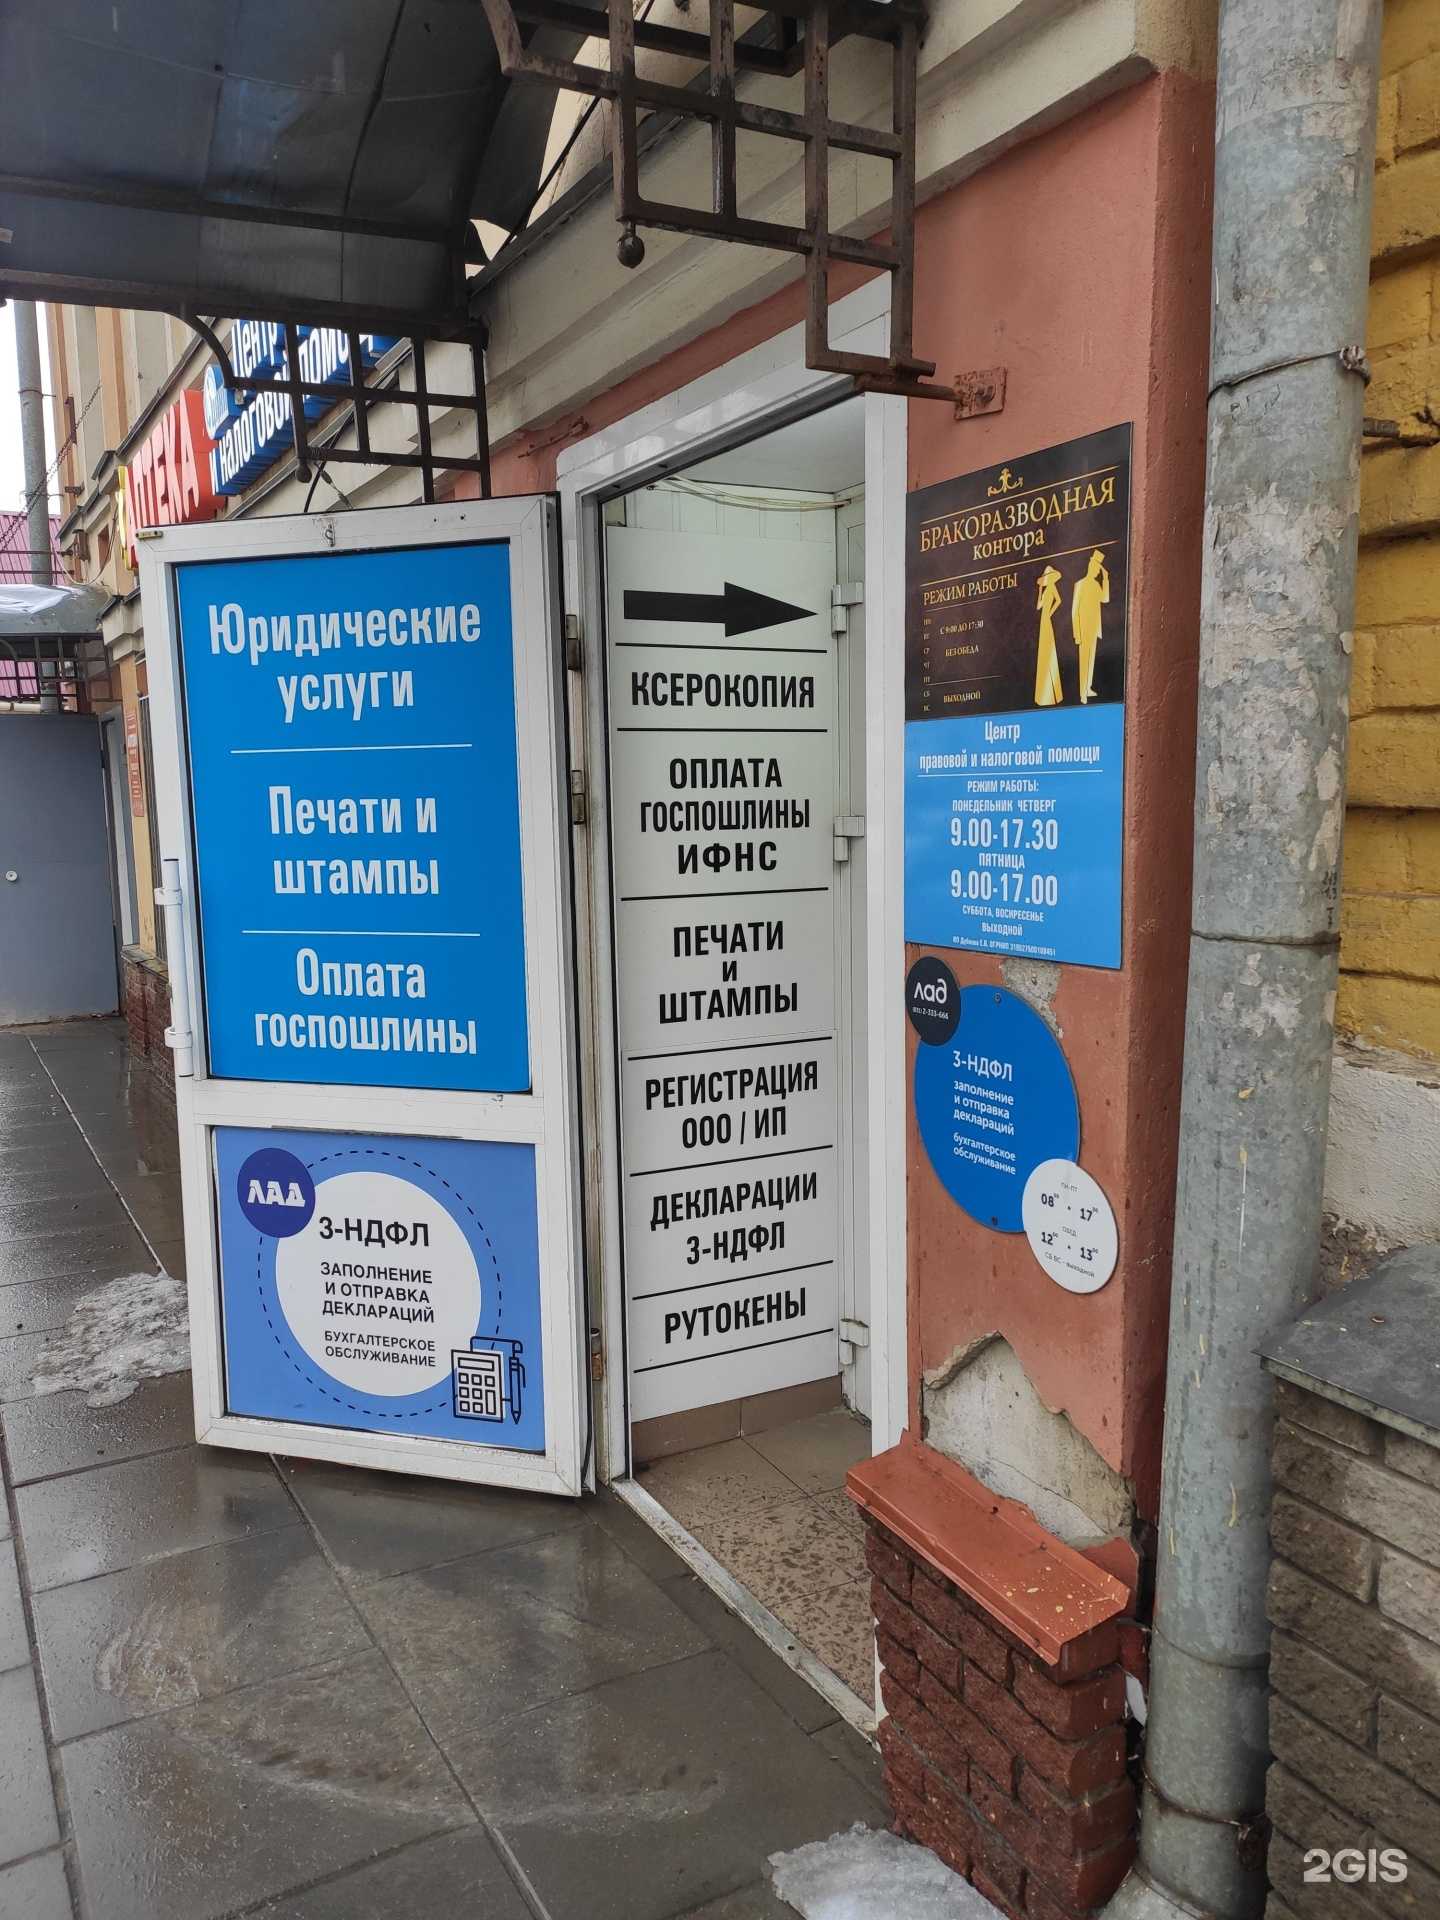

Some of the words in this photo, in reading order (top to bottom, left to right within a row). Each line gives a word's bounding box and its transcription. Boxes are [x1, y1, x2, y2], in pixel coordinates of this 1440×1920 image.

[125, 389, 200, 570] АПТЕКА
[920, 476, 1116, 553] БРАКОРАЗВОДНАЯ
[972, 528, 1046, 561] контора
[923, 583, 966, 606] РЕЖИМ
[968, 572, 1019, 597] РАБОТЫ
[208, 603, 482, 666] Юридические
[277, 670, 415, 724] услуги
[631, 671, 815, 708] КСЕРОКОПИЯ
[984, 720, 1021, 744] Центр
[669, 758, 783, 789] ОПЛАТА
[919, 748, 968, 774] правовой
[970, 754, 978, 768] и
[980, 745, 1043, 767] налоговой
[1047, 745, 1101, 765] помощи
[967, 780, 998, 793] РЕЖИМ
[999, 779, 1040, 793] РАБОТЫ:
[268, 785, 402, 835] Печати
[416, 797, 437, 833] и
[640, 798, 810, 833] ГОСПОШЛИНЫ
[952, 799, 1013, 814] ПОНЕДЕЛЬНИК
[1017, 799, 1057, 813] ЧЕТВЕРГ
[950, 817, 1059, 850] 9.00-17.30
[678, 841, 778, 875] ИФНС
[978, 851, 1025, 871] ПЯТНИЦА
[273, 858, 439, 895] штампы
[950, 868, 1058, 906] 9.00-17.00
[981, 922, 1024, 937] ВЫХОДНОЙ
[995, 907, 1045, 923] ВОСКРЕСЕНЬЕ
[673, 920, 784, 958] ПЕЧАТИ
[296, 947, 427, 999] Оплата
[659, 982, 798, 1025] ШТАМПЫ
[254, 1012, 478, 1055] госпошлины
[952, 1050, 1014, 1082] 3-НДФЛ
[645, 1060, 818, 1111] РЕГИСТРАЦИЯ
[953, 1080, 1015, 1106] заполнение
[953, 1108, 1015, 1136] деклараций
[954, 1094, 961, 1105] и
[962, 1096, 1010, 1120] отправка
[682, 1112, 732, 1149] ООО
[740, 1111, 746, 1145] /
[754, 1105, 787, 1139] ИП
[953, 1132, 1016, 1161] бухгалтерское
[953, 1146, 1016, 1175] обслуживание
[247, 1179, 306, 1208] ЛАД
[650, 1171, 818, 1232] ДЕКЛАРАЦИИ
[319, 1216, 430, 1249] 3-НДФЛ
[686, 1221, 786, 1265] 3-НДФЛ
[320, 1261, 433, 1284] ЗАПОЛНЕНИЕ
[325, 1282, 336, 1295] И
[340, 1283, 430, 1303] ОТПРАВКА
[322, 1300, 435, 1323] ДЕКЛАРАЦИЙ
[664, 1287, 807, 1345] РУТОКЕНЫ
[324, 1330, 436, 1352] БУХГАЛТЕРСКОЕ
[325, 1346, 436, 1367] ОБСЛУЖИВАНИЕ
